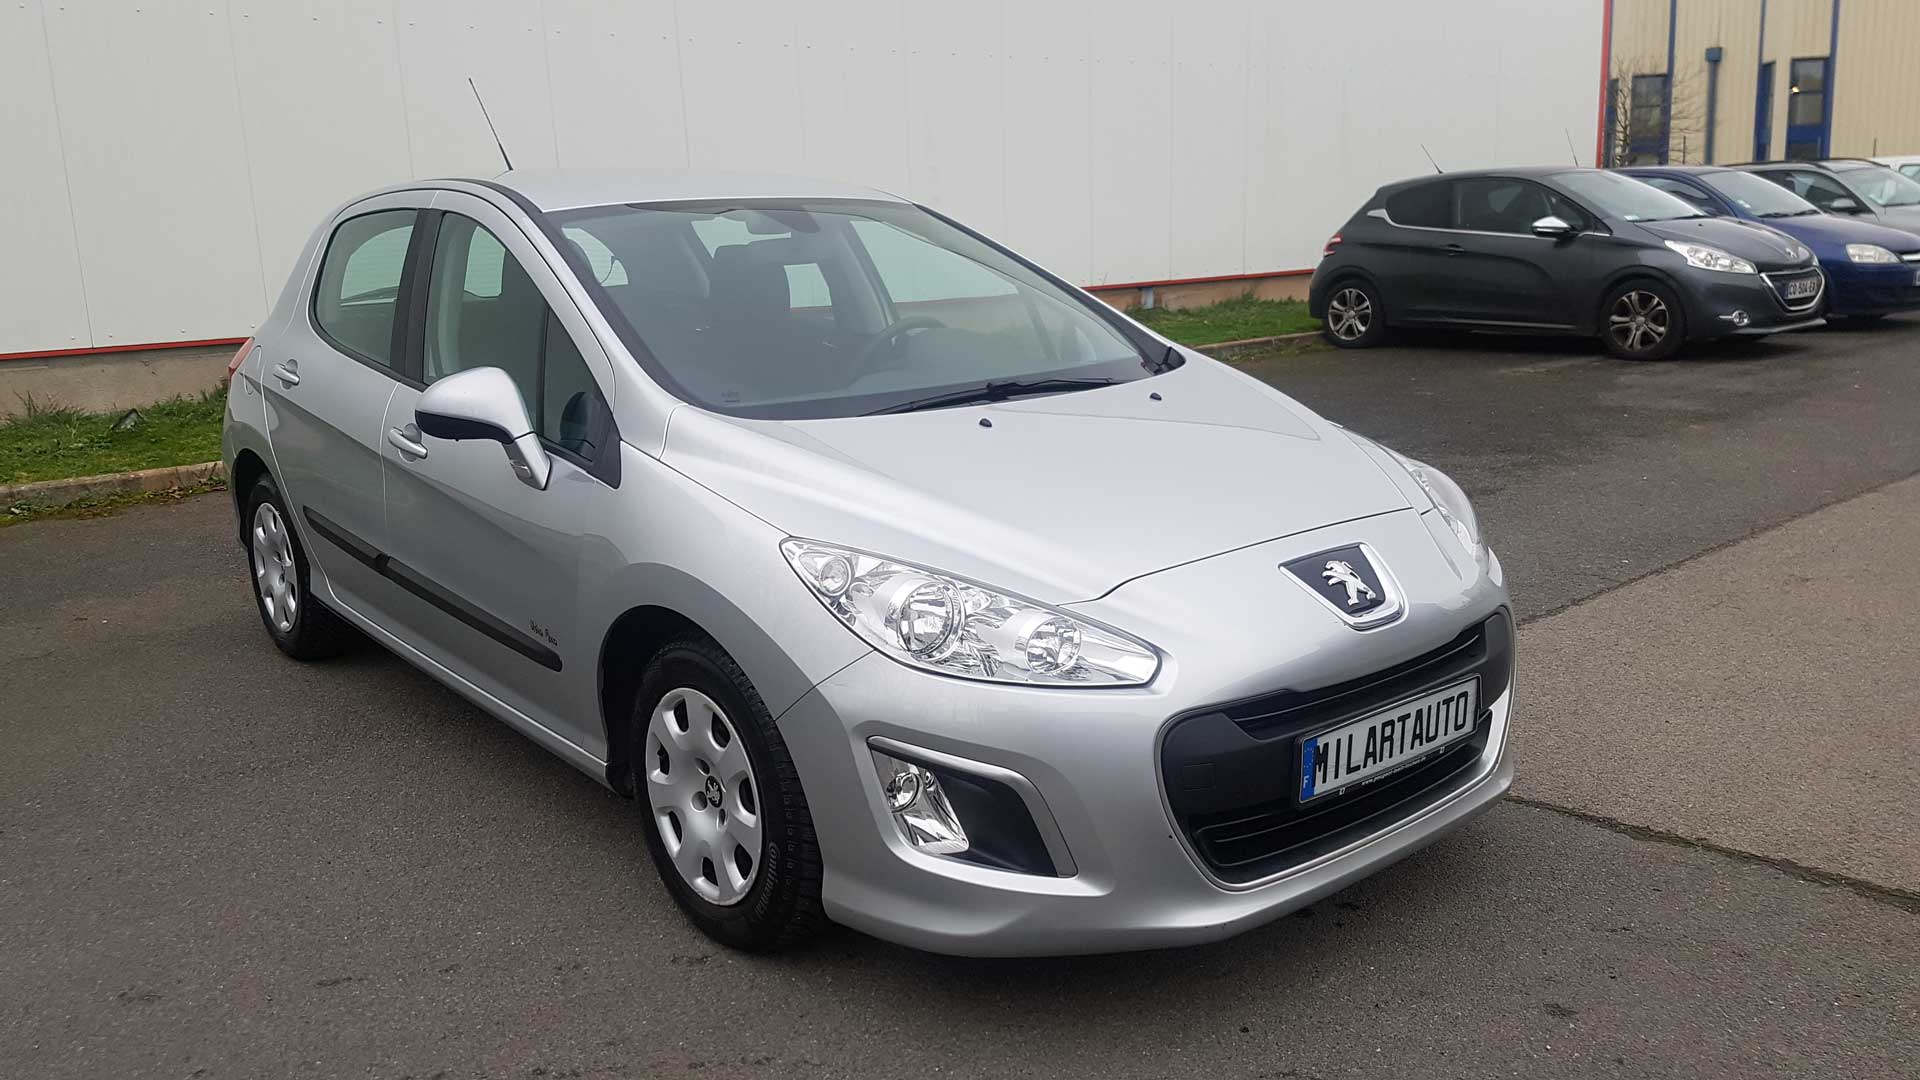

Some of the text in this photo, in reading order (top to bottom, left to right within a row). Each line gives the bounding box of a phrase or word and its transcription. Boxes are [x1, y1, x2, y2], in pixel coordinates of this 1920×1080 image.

[1313, 691, 1469, 788] MILARTAUTO
[1303, 776, 1309, 789] F
[753, 840, 781, 919] Continental
